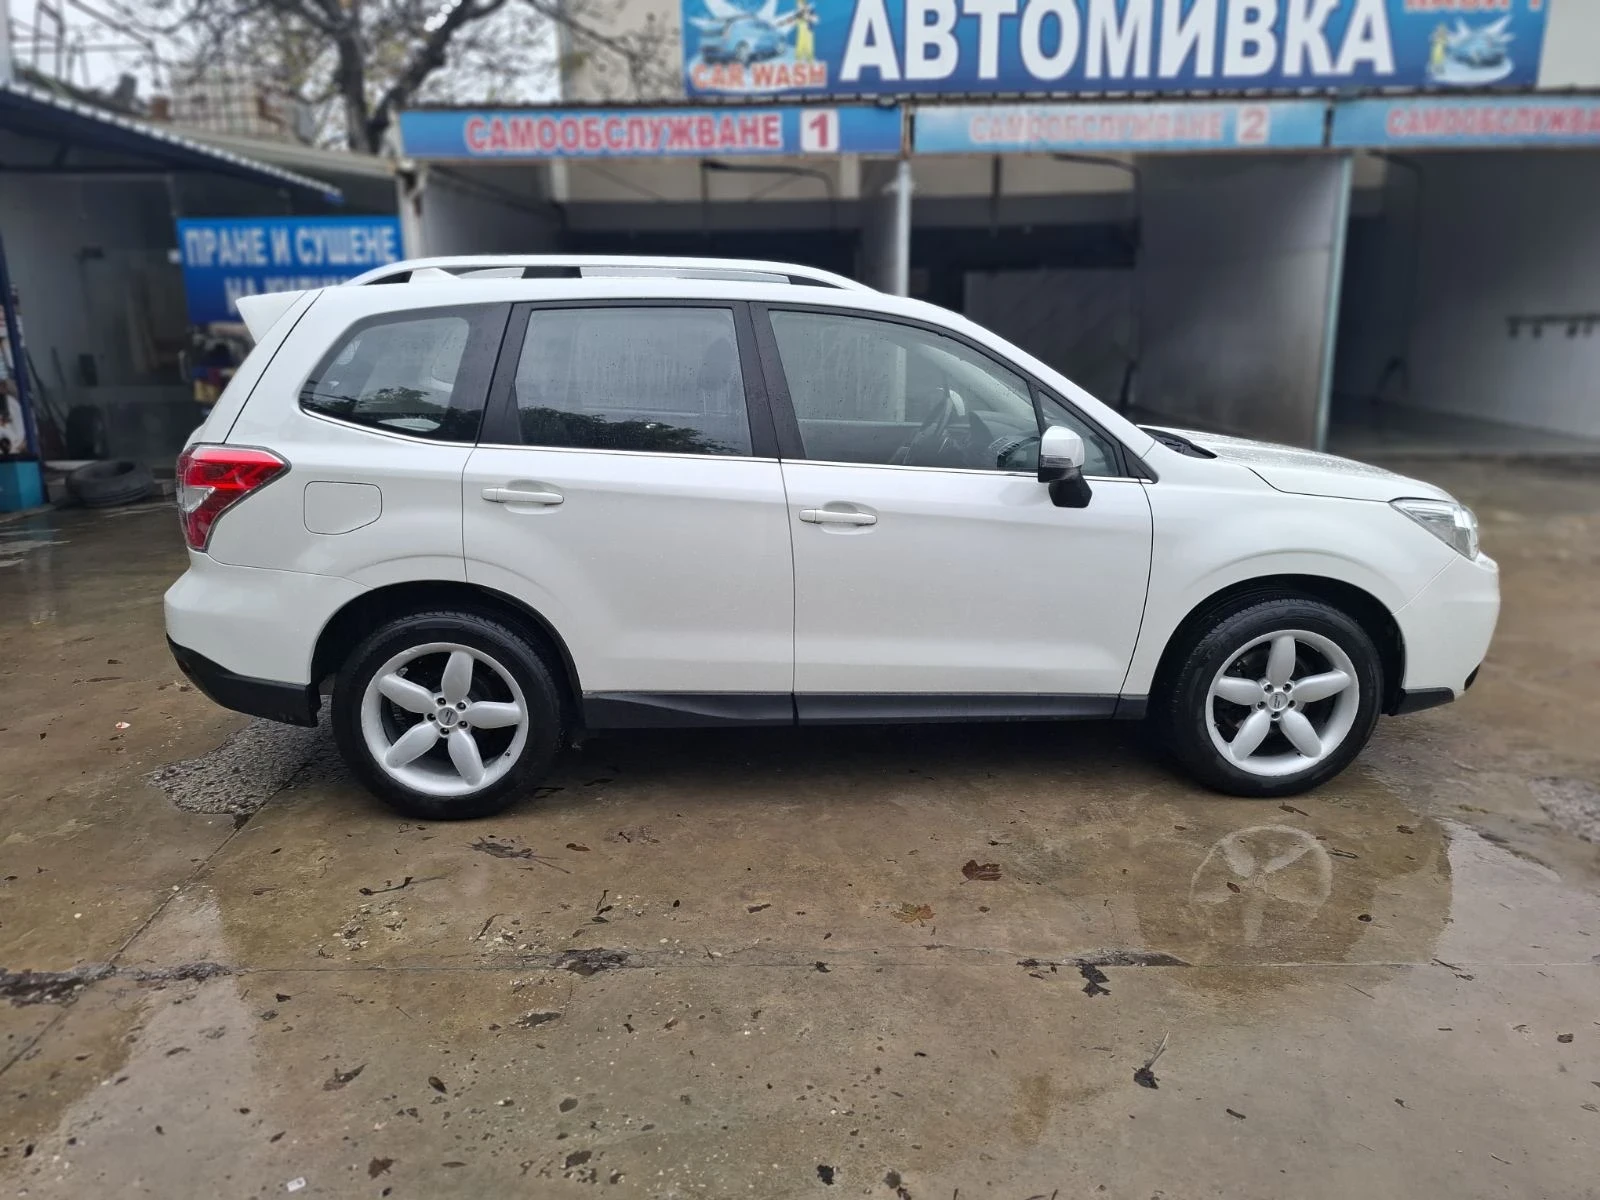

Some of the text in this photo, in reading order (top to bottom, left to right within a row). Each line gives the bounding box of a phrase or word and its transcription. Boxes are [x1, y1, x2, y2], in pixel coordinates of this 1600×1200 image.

[840, 0, 1394, 80] АВТОМИВКА
[691, 61, 827, 89] CAR WASH
[465, 112, 830, 152] САМООБСЛУЖВАНЕ 1
[1240, 107, 1268, 142] 2
[184, 225, 397, 267] ПРАНЕ И СУШЕНЕ
